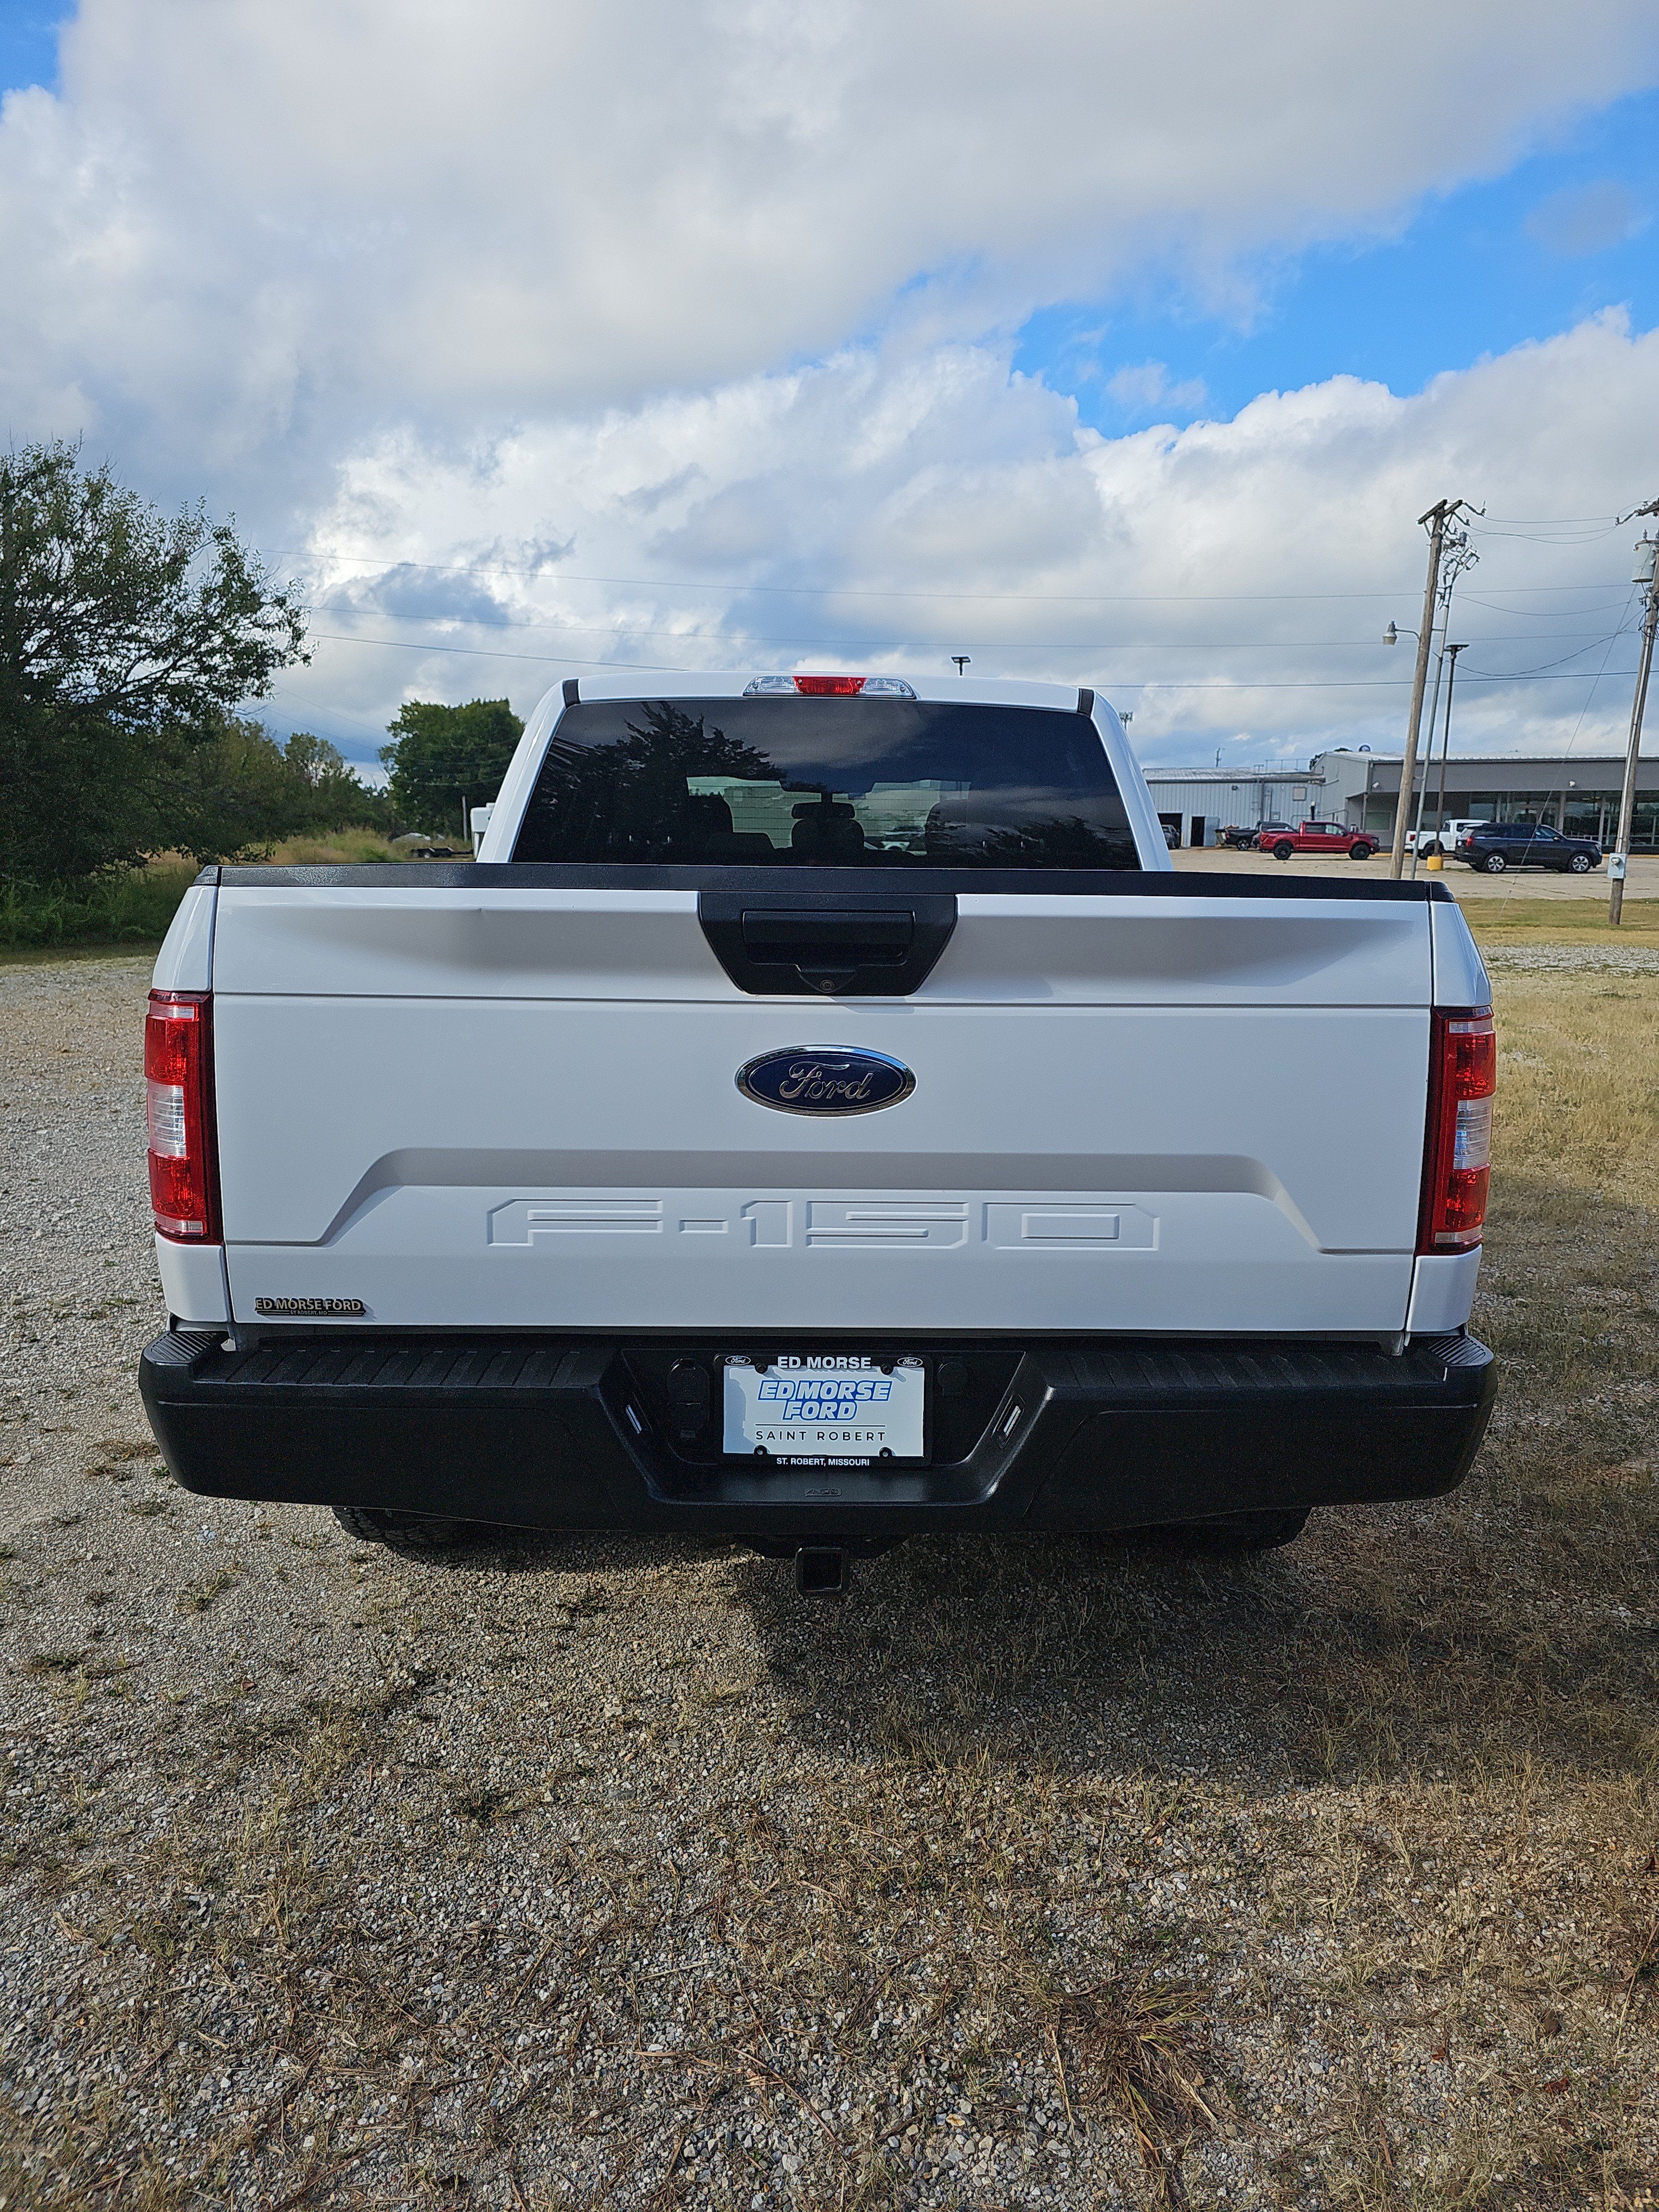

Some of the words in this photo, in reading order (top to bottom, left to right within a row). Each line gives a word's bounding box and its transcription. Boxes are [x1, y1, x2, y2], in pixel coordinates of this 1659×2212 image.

[780, 1061, 873, 1099] Ford
[488, 1199, 1160, 1251] F-150
[256, 1299, 273, 1309] ED
[276, 1299, 321, 1310] MORSE
[325, 1300, 361, 1310] FORD
[777, 1356, 801, 1368] ED
[807, 1356, 871, 1369] MORSE
[758, 1380, 795, 1400] ED
[796, 1380, 892, 1401] MORSE
[783, 1400, 858, 1420] FORD
[756, 1431, 807, 1440] SAINT
[817, 1431, 885, 1441] ROBERT
[790, 1458, 826, 1467] ROBERT,
